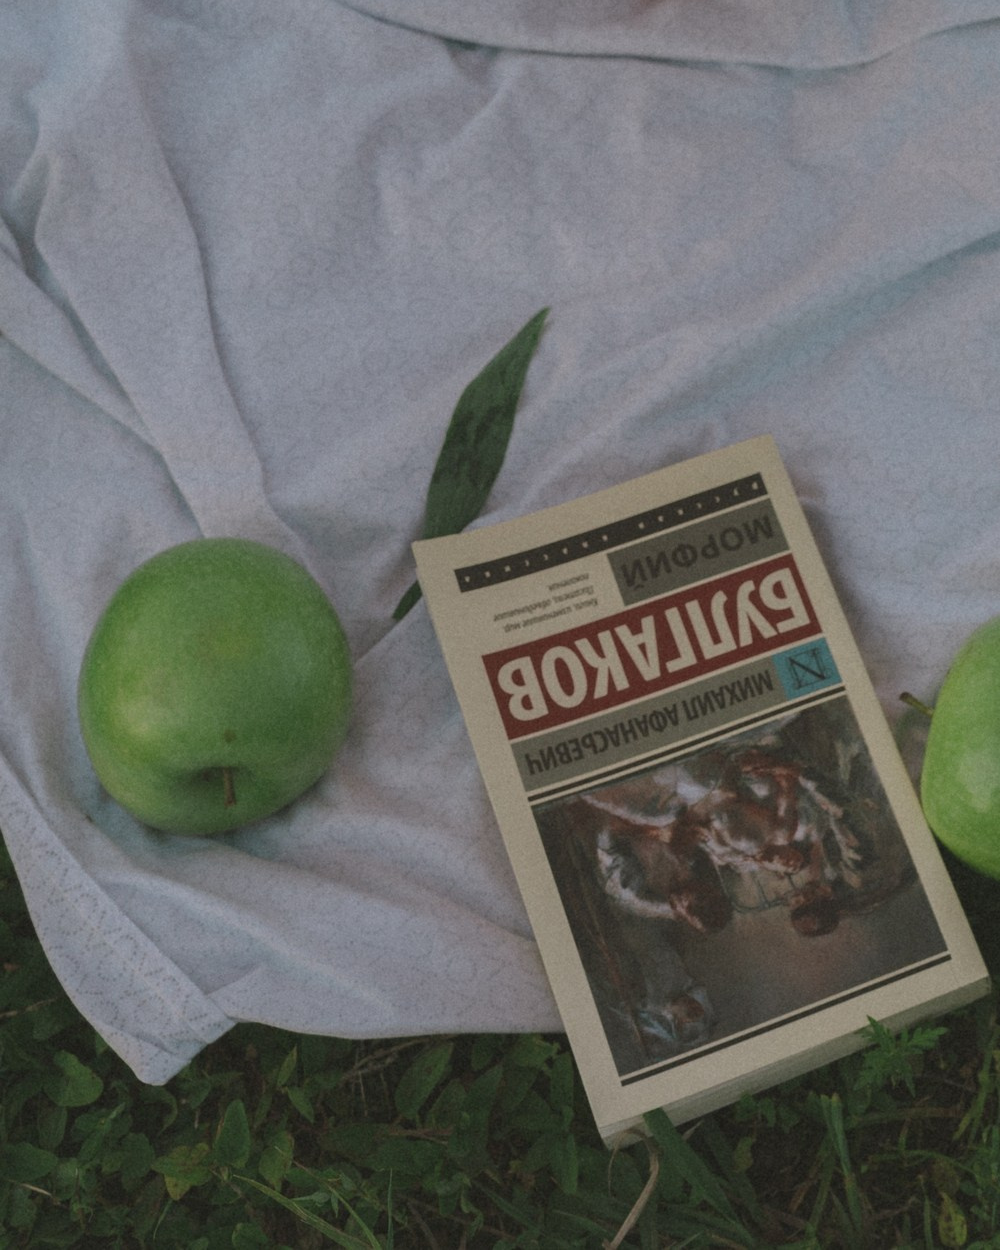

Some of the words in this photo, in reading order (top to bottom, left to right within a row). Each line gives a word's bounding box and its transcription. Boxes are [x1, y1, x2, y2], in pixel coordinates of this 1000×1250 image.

[621, 514, 774, 592] МОРФИЙ
[497, 567, 811, 722] БУЛГАКОВ
[686, 669, 775, 722] МИХАИЛ
[524, 702, 680, 776] АФАНАСЬЕВИЧ
